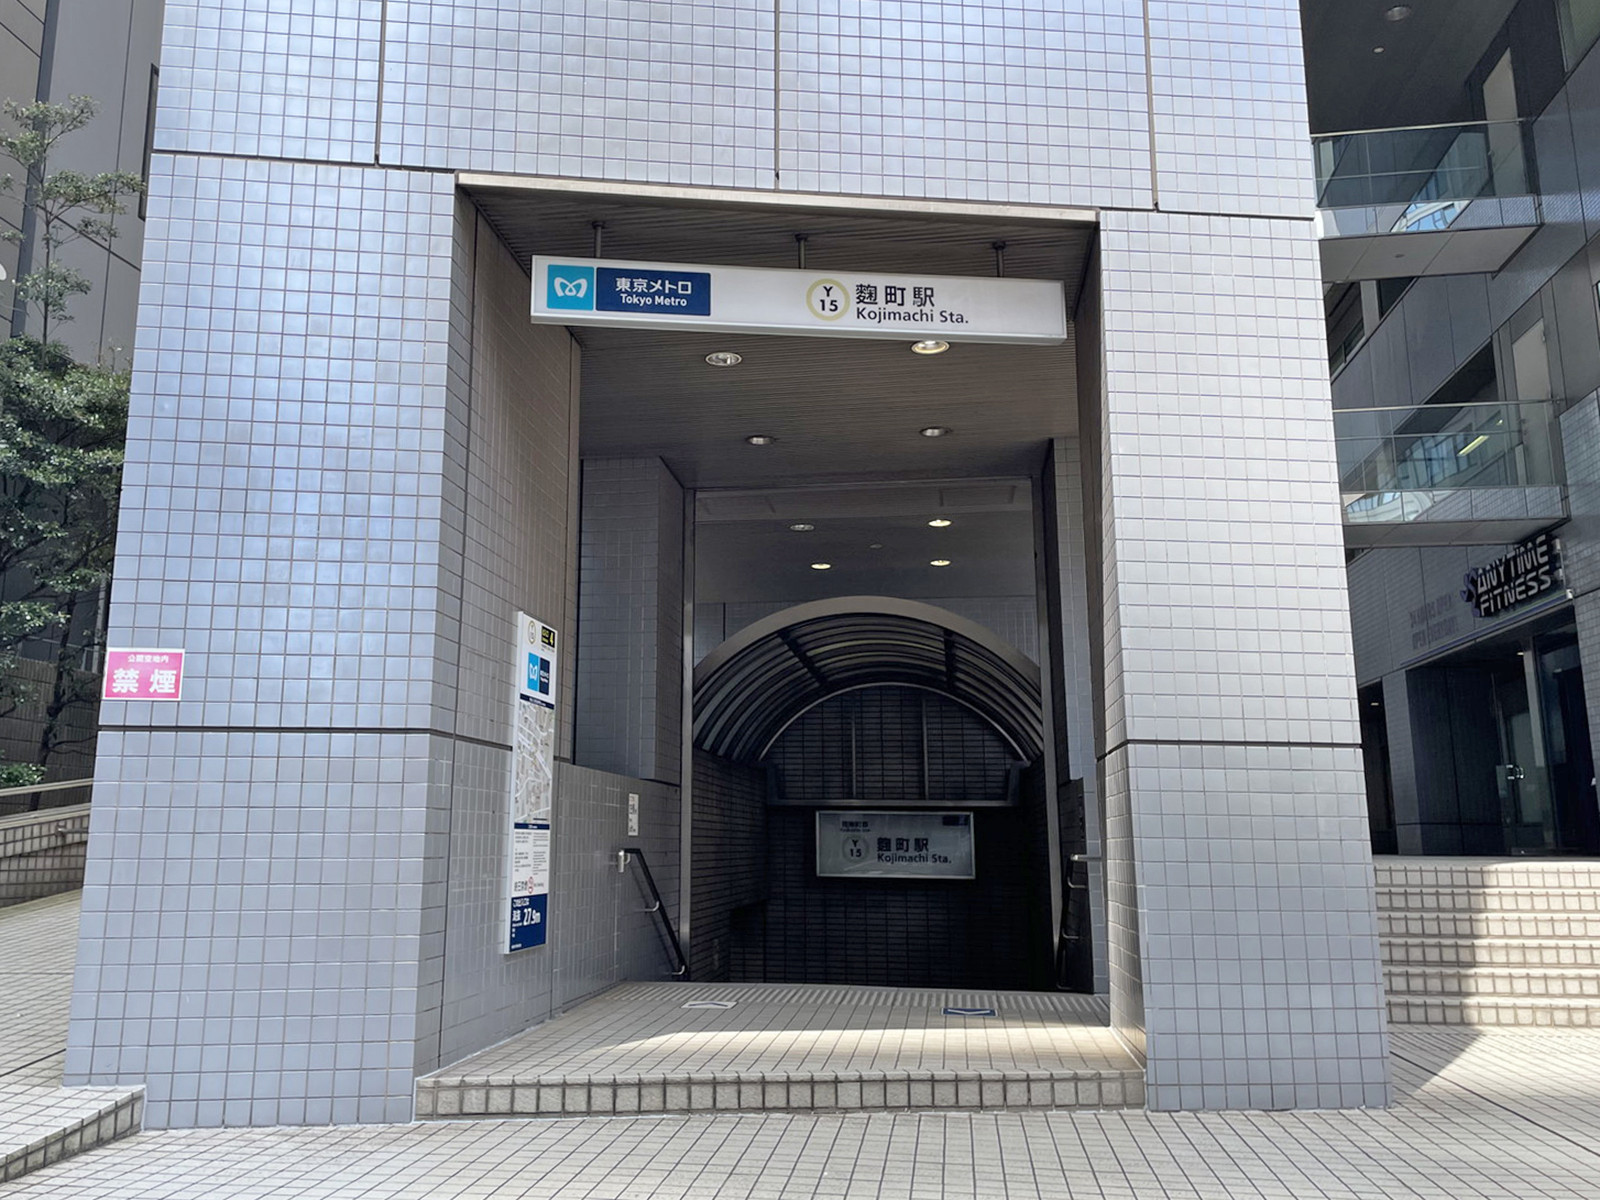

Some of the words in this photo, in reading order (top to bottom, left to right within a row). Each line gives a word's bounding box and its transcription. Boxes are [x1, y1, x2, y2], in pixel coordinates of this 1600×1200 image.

[616, 277, 692, 294] 東京メトロ
[823, 286, 833, 297] Y
[620, 293, 652, 305] Tokyo
[654, 296, 687, 307] Metro
[819, 299, 839, 312] 15
[856, 307, 934, 324] Kojimachi
[939, 310, 969, 324] Sta.
[1477, 534, 1550, 595] ANYTIME
[1479, 564, 1552, 617] FITNESS
[112, 668, 177, 694] 禁煙
[852, 839, 859, 848] Y
[850, 848, 862, 858] 15
[877, 853, 929, 864] Kojimachi
[931, 854, 952, 864] Sta.
